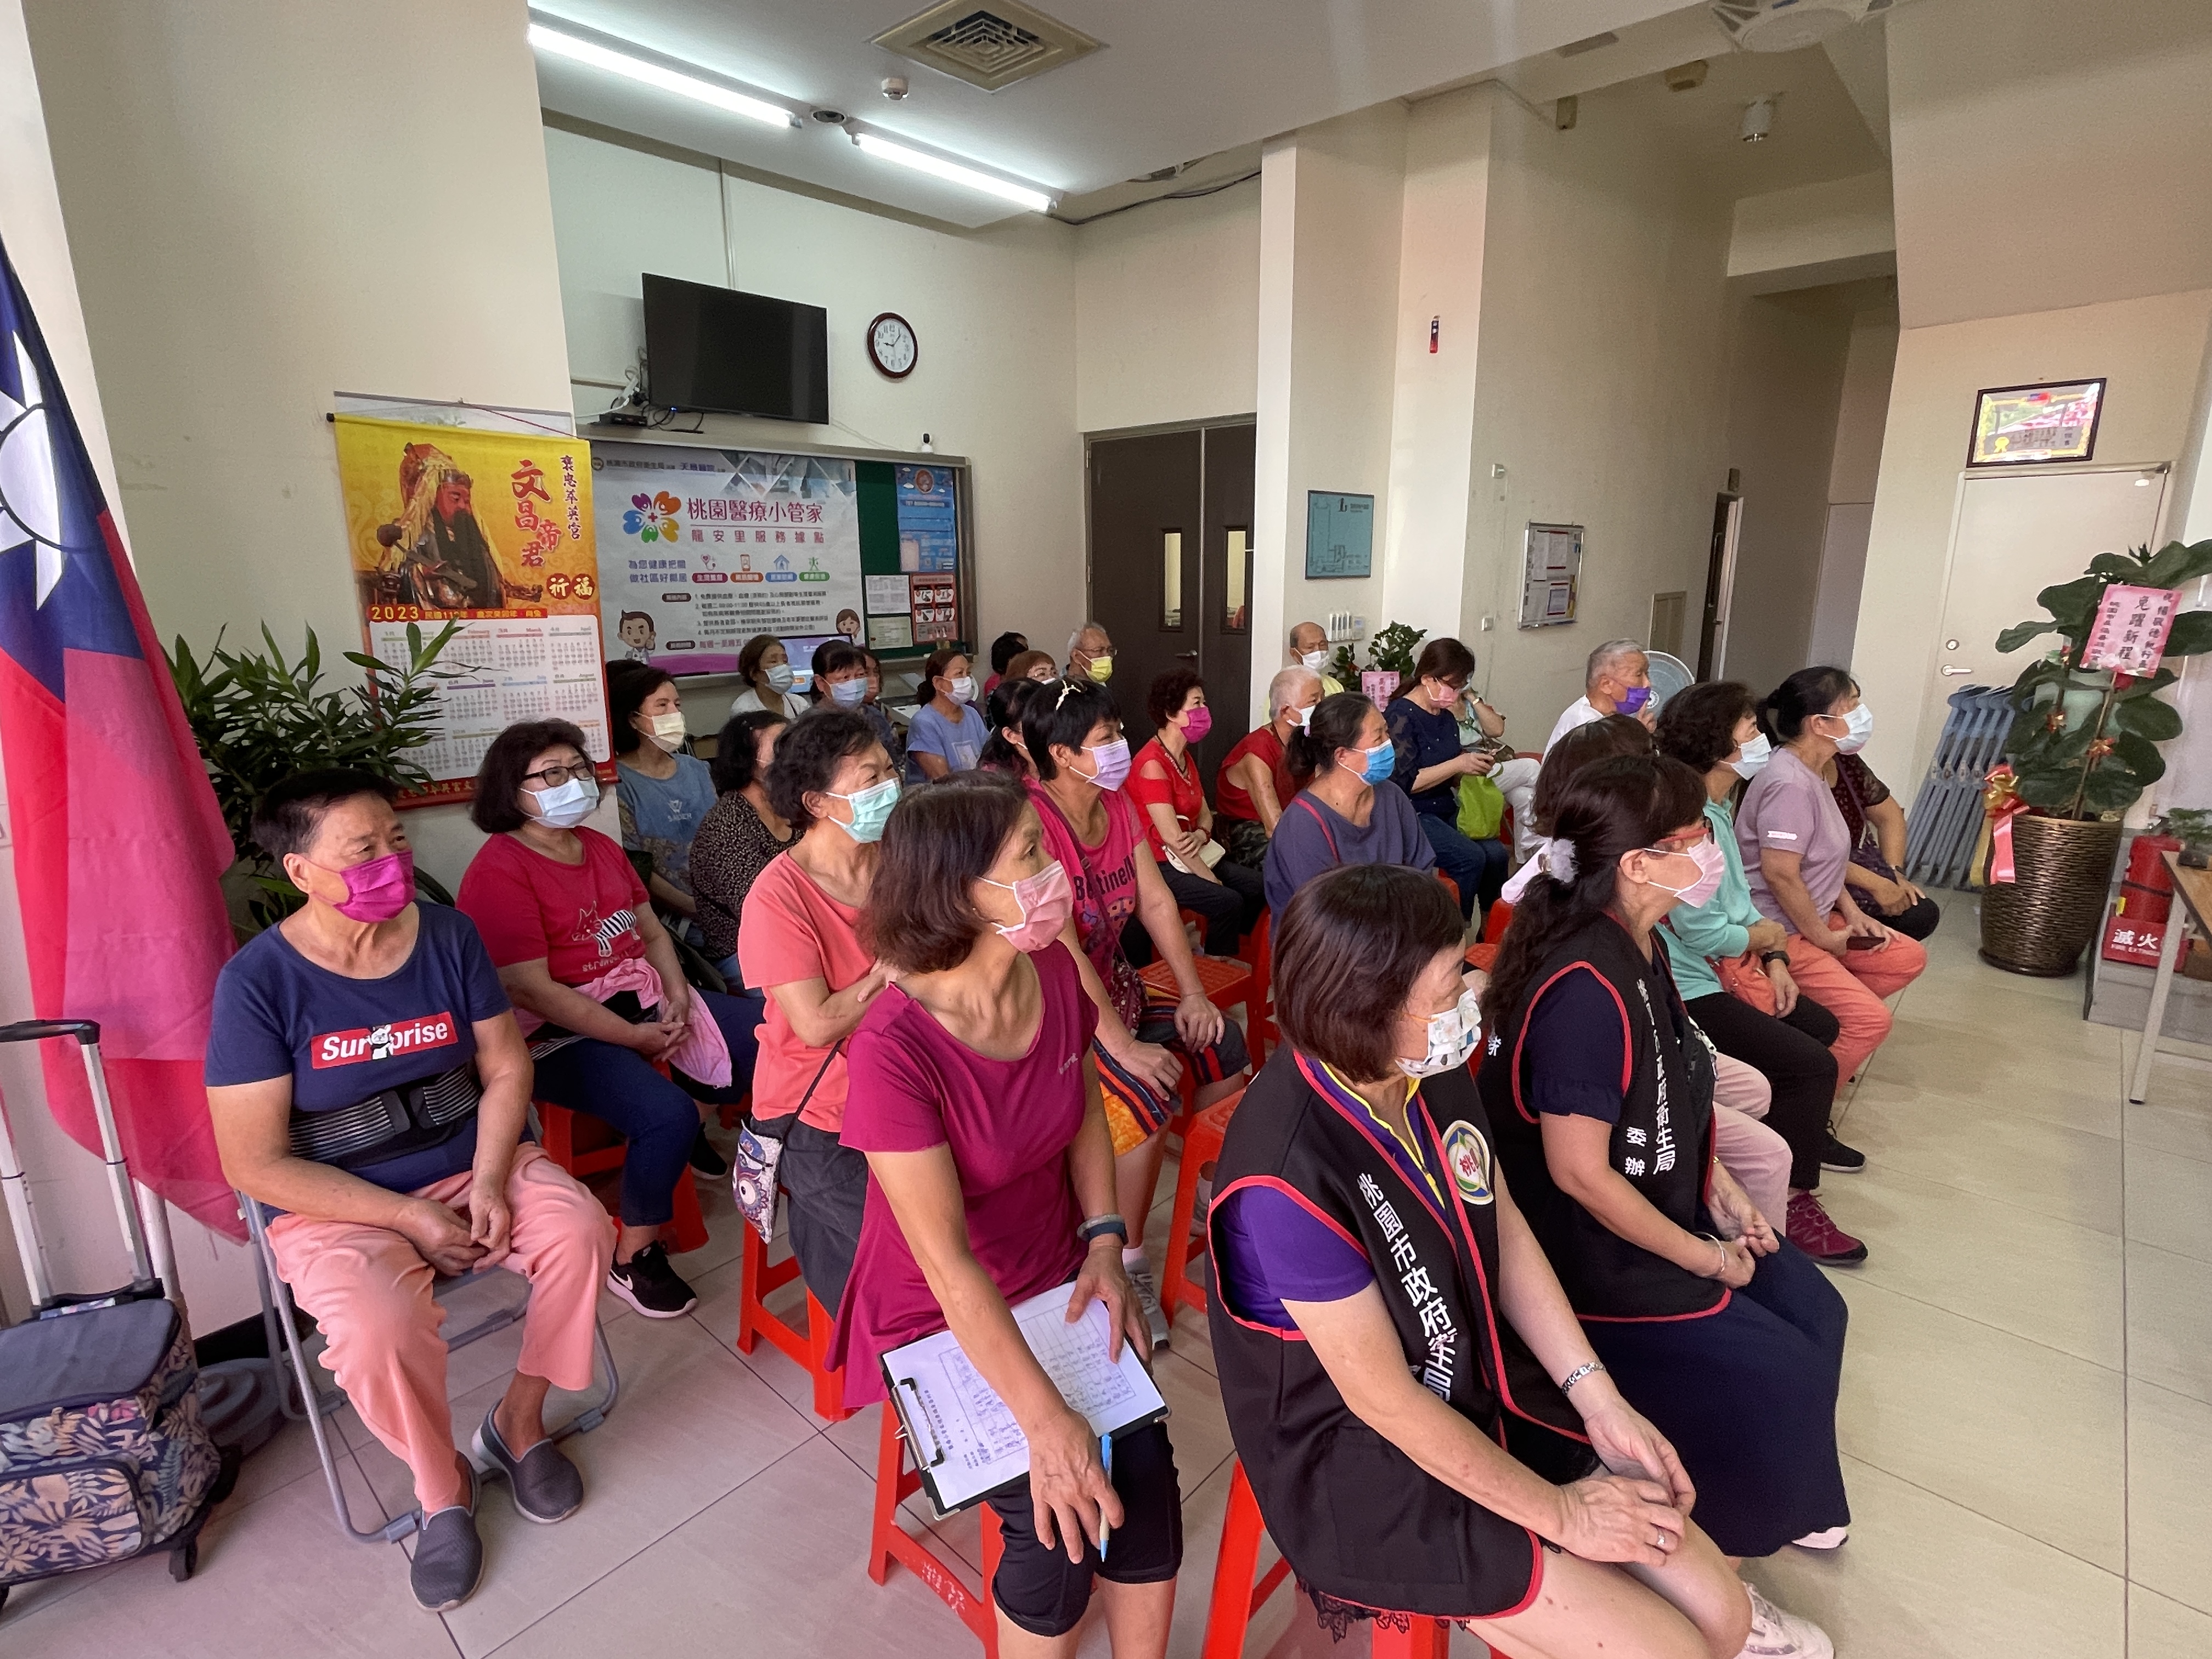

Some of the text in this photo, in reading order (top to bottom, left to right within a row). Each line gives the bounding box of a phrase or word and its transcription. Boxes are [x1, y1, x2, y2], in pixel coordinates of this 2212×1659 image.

[511, 460, 562, 568] 文昌帝君
[686, 497, 824, 523] 桃園醫療小管家
[691, 529, 825, 544] 龍安里服務據點
[549, 577, 594, 598] 祈福
[371, 606, 419, 620] 2023
[2112, 928, 2162, 951] 滅火
[1459, 1148, 1479, 1177] 桃
[1625, 1126, 1647, 1176] 委辦
